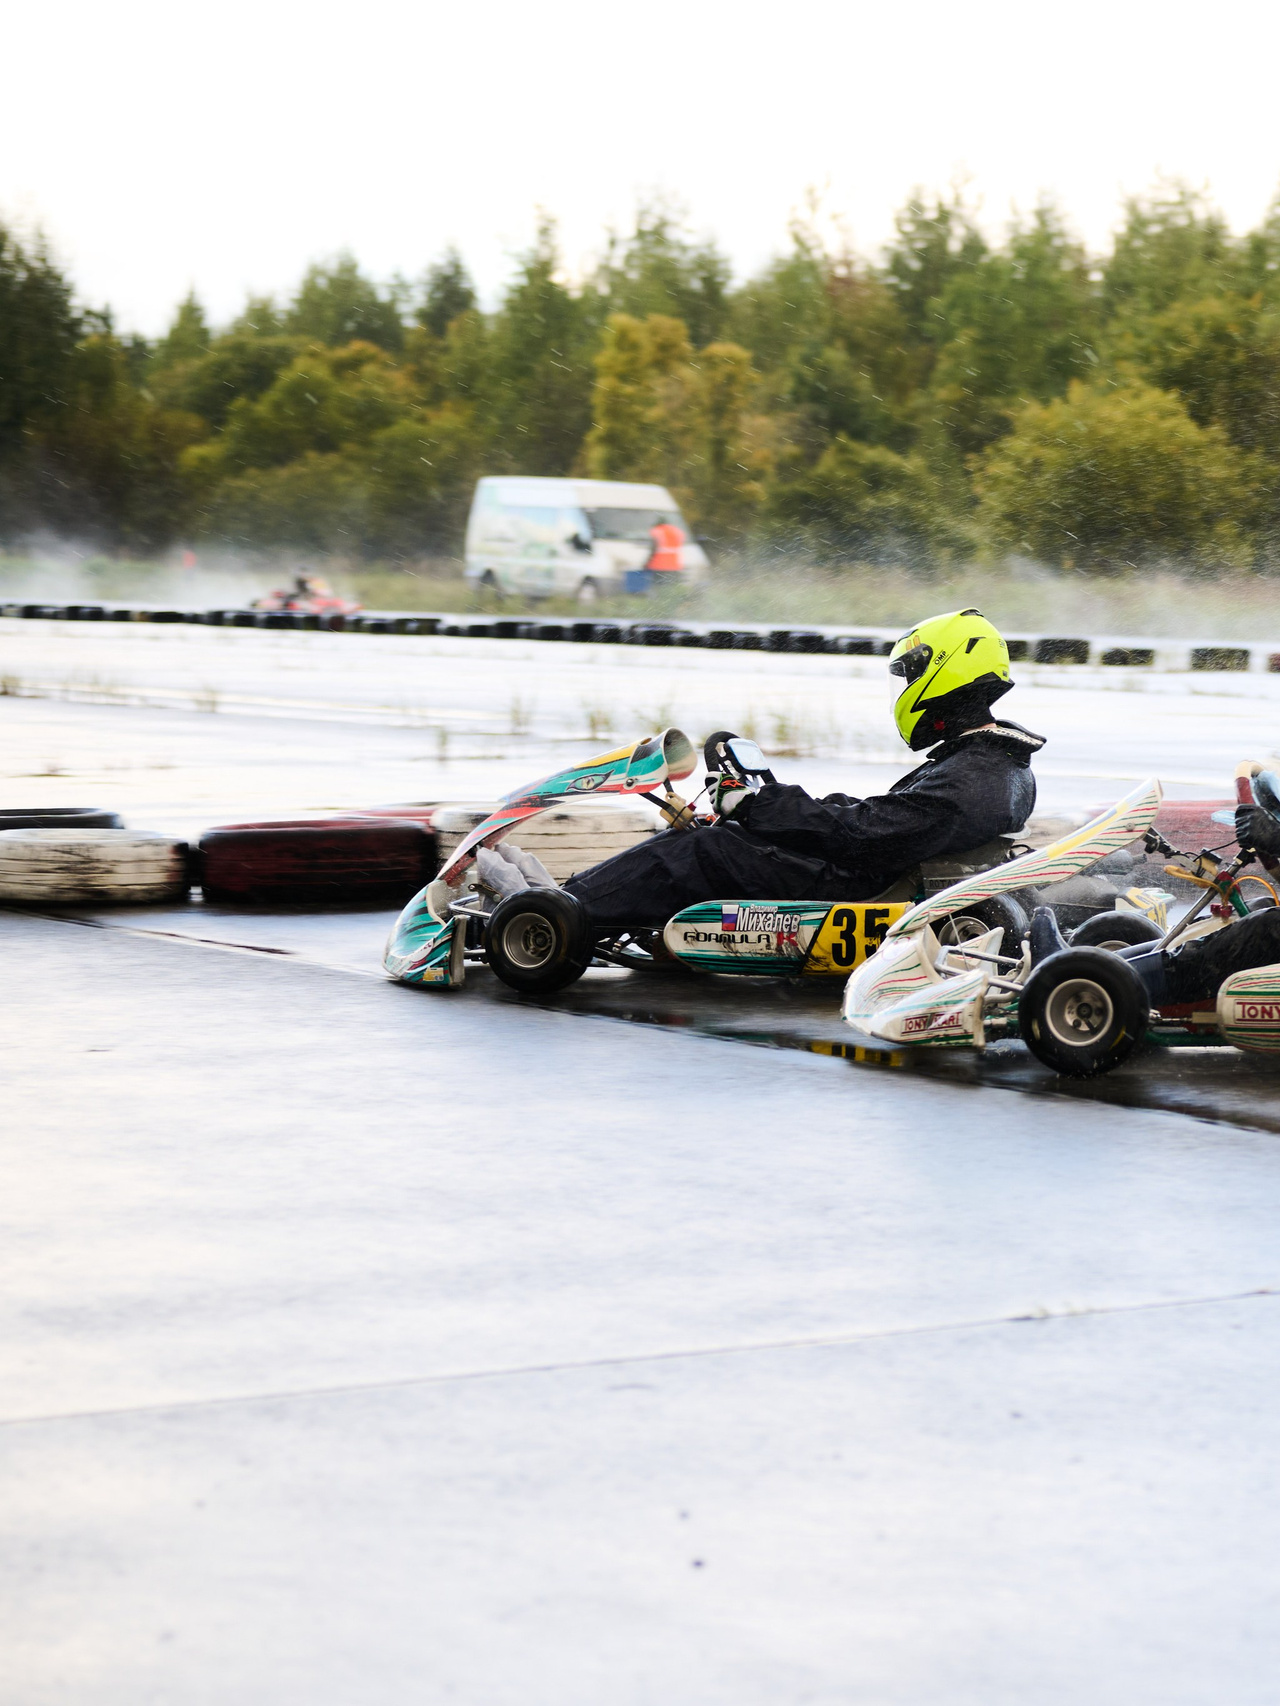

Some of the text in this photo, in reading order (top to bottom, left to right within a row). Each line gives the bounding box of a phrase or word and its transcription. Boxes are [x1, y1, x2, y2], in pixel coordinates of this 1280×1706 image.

[934, 650, 947, 665] OMP
[736, 907, 800, 932] Михалев
[683, 931, 771, 944] FORMULA
[832, 908, 890, 967] 35
[904, 1016, 928, 1031] TONY
